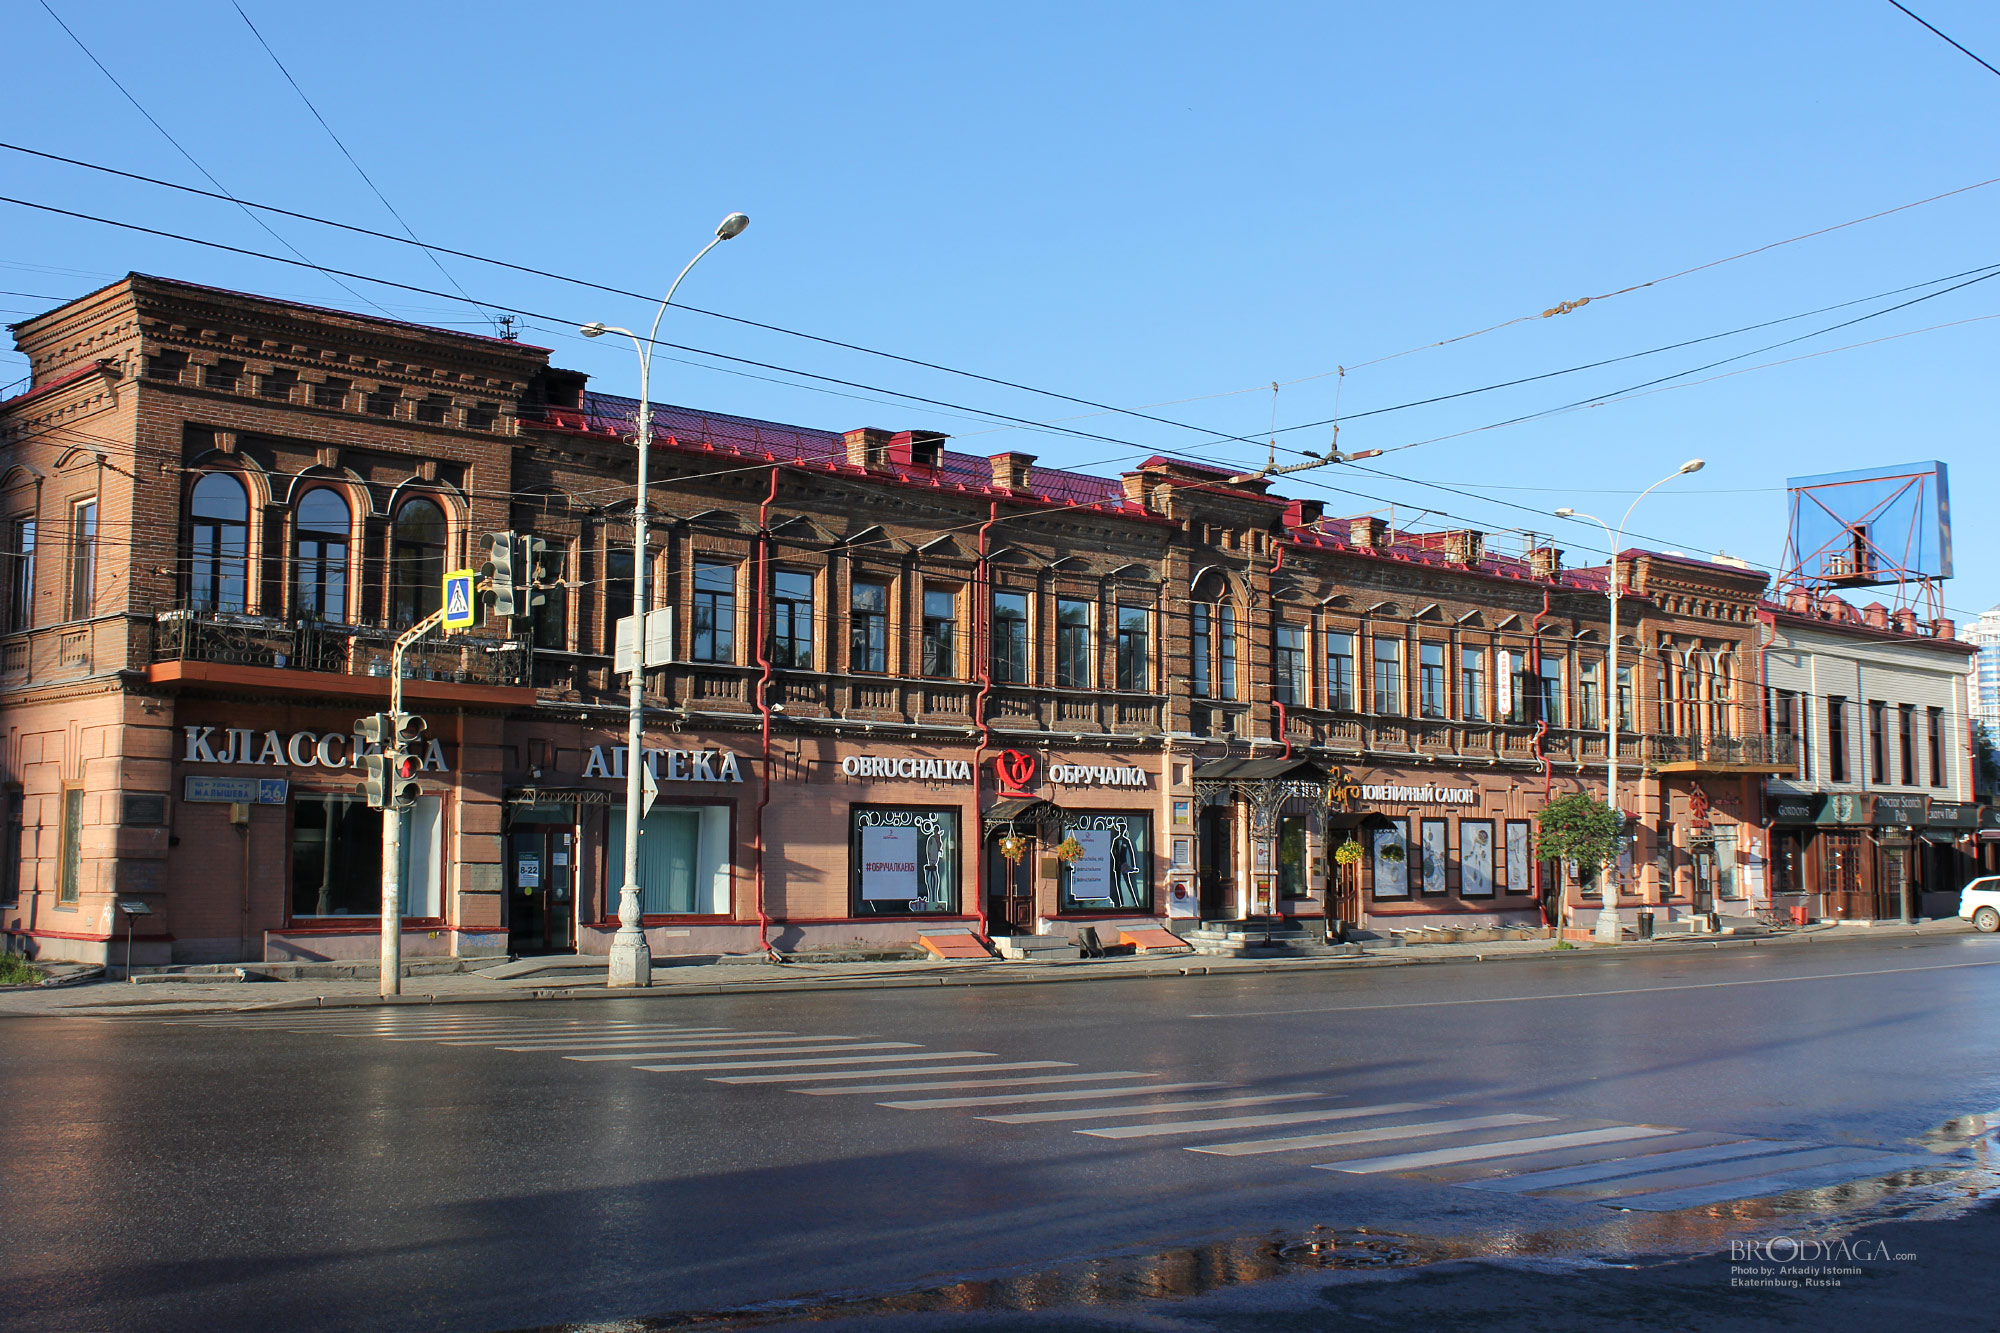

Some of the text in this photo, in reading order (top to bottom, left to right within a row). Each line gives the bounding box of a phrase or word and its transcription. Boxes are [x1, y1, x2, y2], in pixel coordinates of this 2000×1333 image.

[183, 725, 450, 773] КЛАССИА
[842, 755, 972, 781] OBRUCHALKA
[1049, 764, 1148, 787] ОБРУЧАЛКА
[194, 789, 249, 798] МАЛЫШЕВА
[265, 785, 281, 799] 56
[1362, 784, 1433, 803] ЮВЕЛИРНЫЙ
[1435, 788, 1474, 804] САЛОН
[1895, 809, 1908, 822] Pub
[520, 866, 538, 874] 8-22
